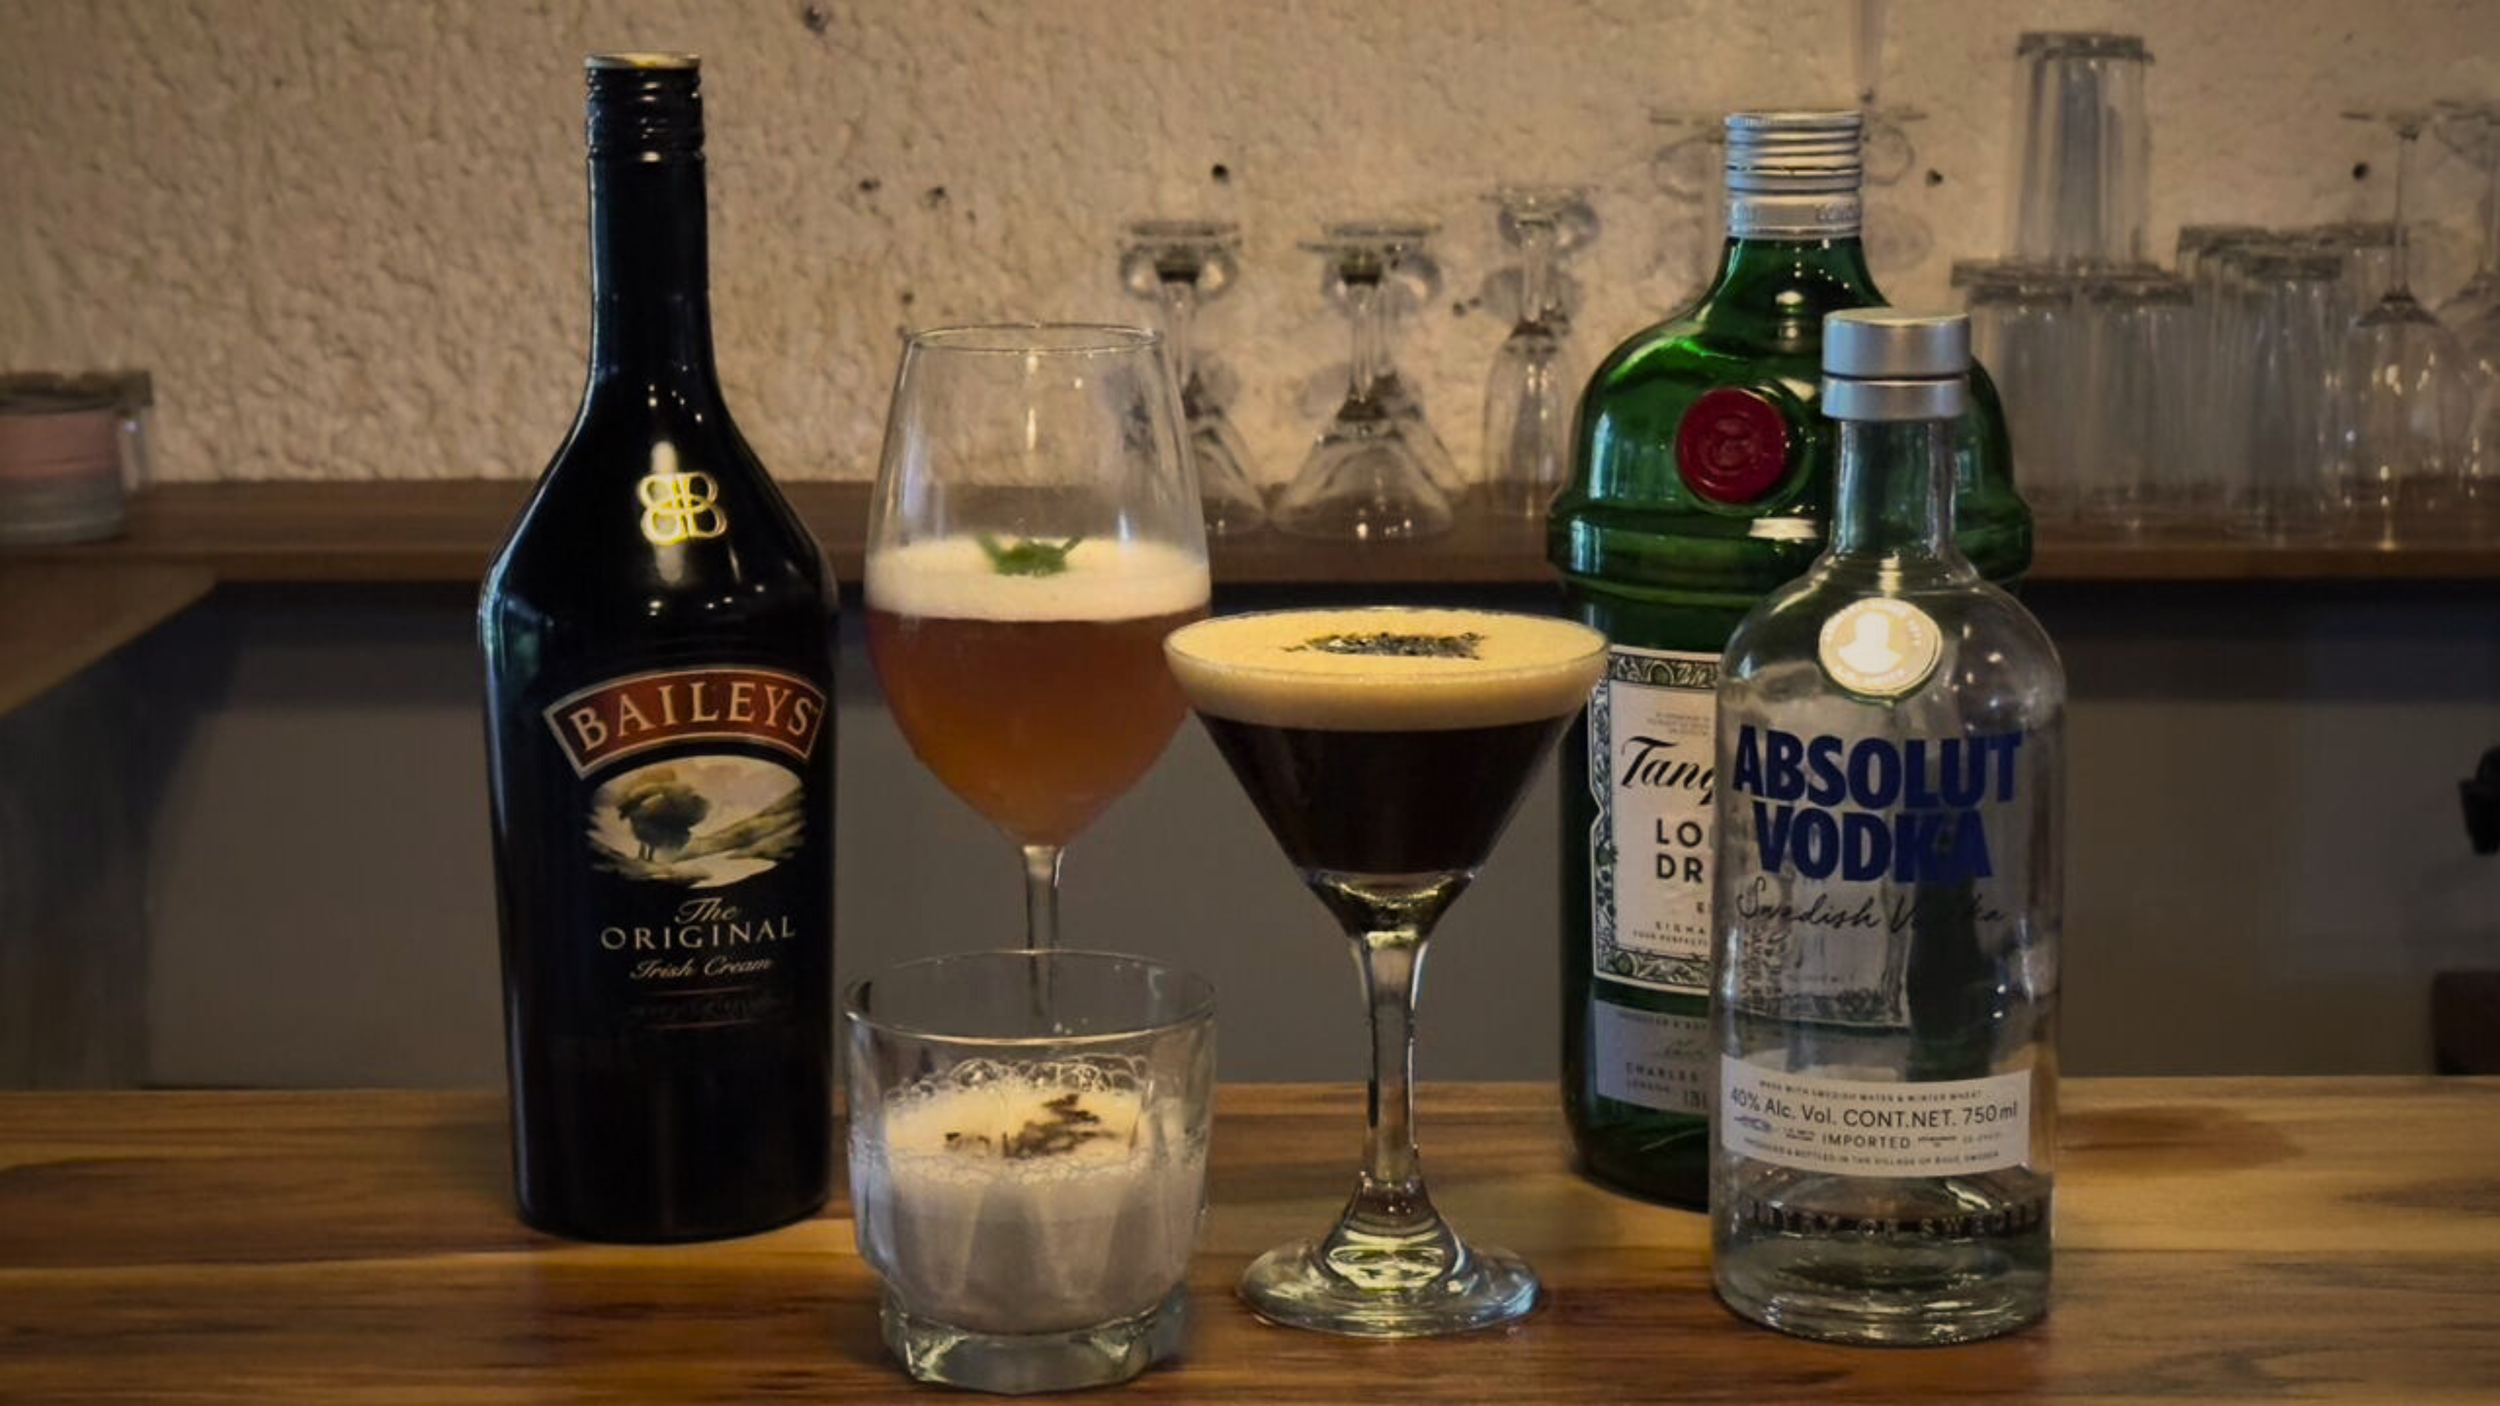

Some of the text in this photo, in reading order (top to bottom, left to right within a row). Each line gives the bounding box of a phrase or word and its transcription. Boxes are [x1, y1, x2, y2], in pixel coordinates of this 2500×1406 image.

[568, 680, 817, 751] BAILEYS
[1732, 724, 2022, 810] ABSOLUT
[1752, 800, 1993, 883] VODKA
[673, 896, 738, 925] The
[1735, 876, 1881, 929] Swedish
[600, 915, 797, 951] ORIGINAL
[628, 955, 773, 980] Irish Cream
[1730, 1087, 1761, 1112] 40%
[1765, 1097, 1797, 1120] Alc.
[1801, 1104, 1837, 1125] Vol.
[1822, 1133, 1912, 1149] IMPORTED
